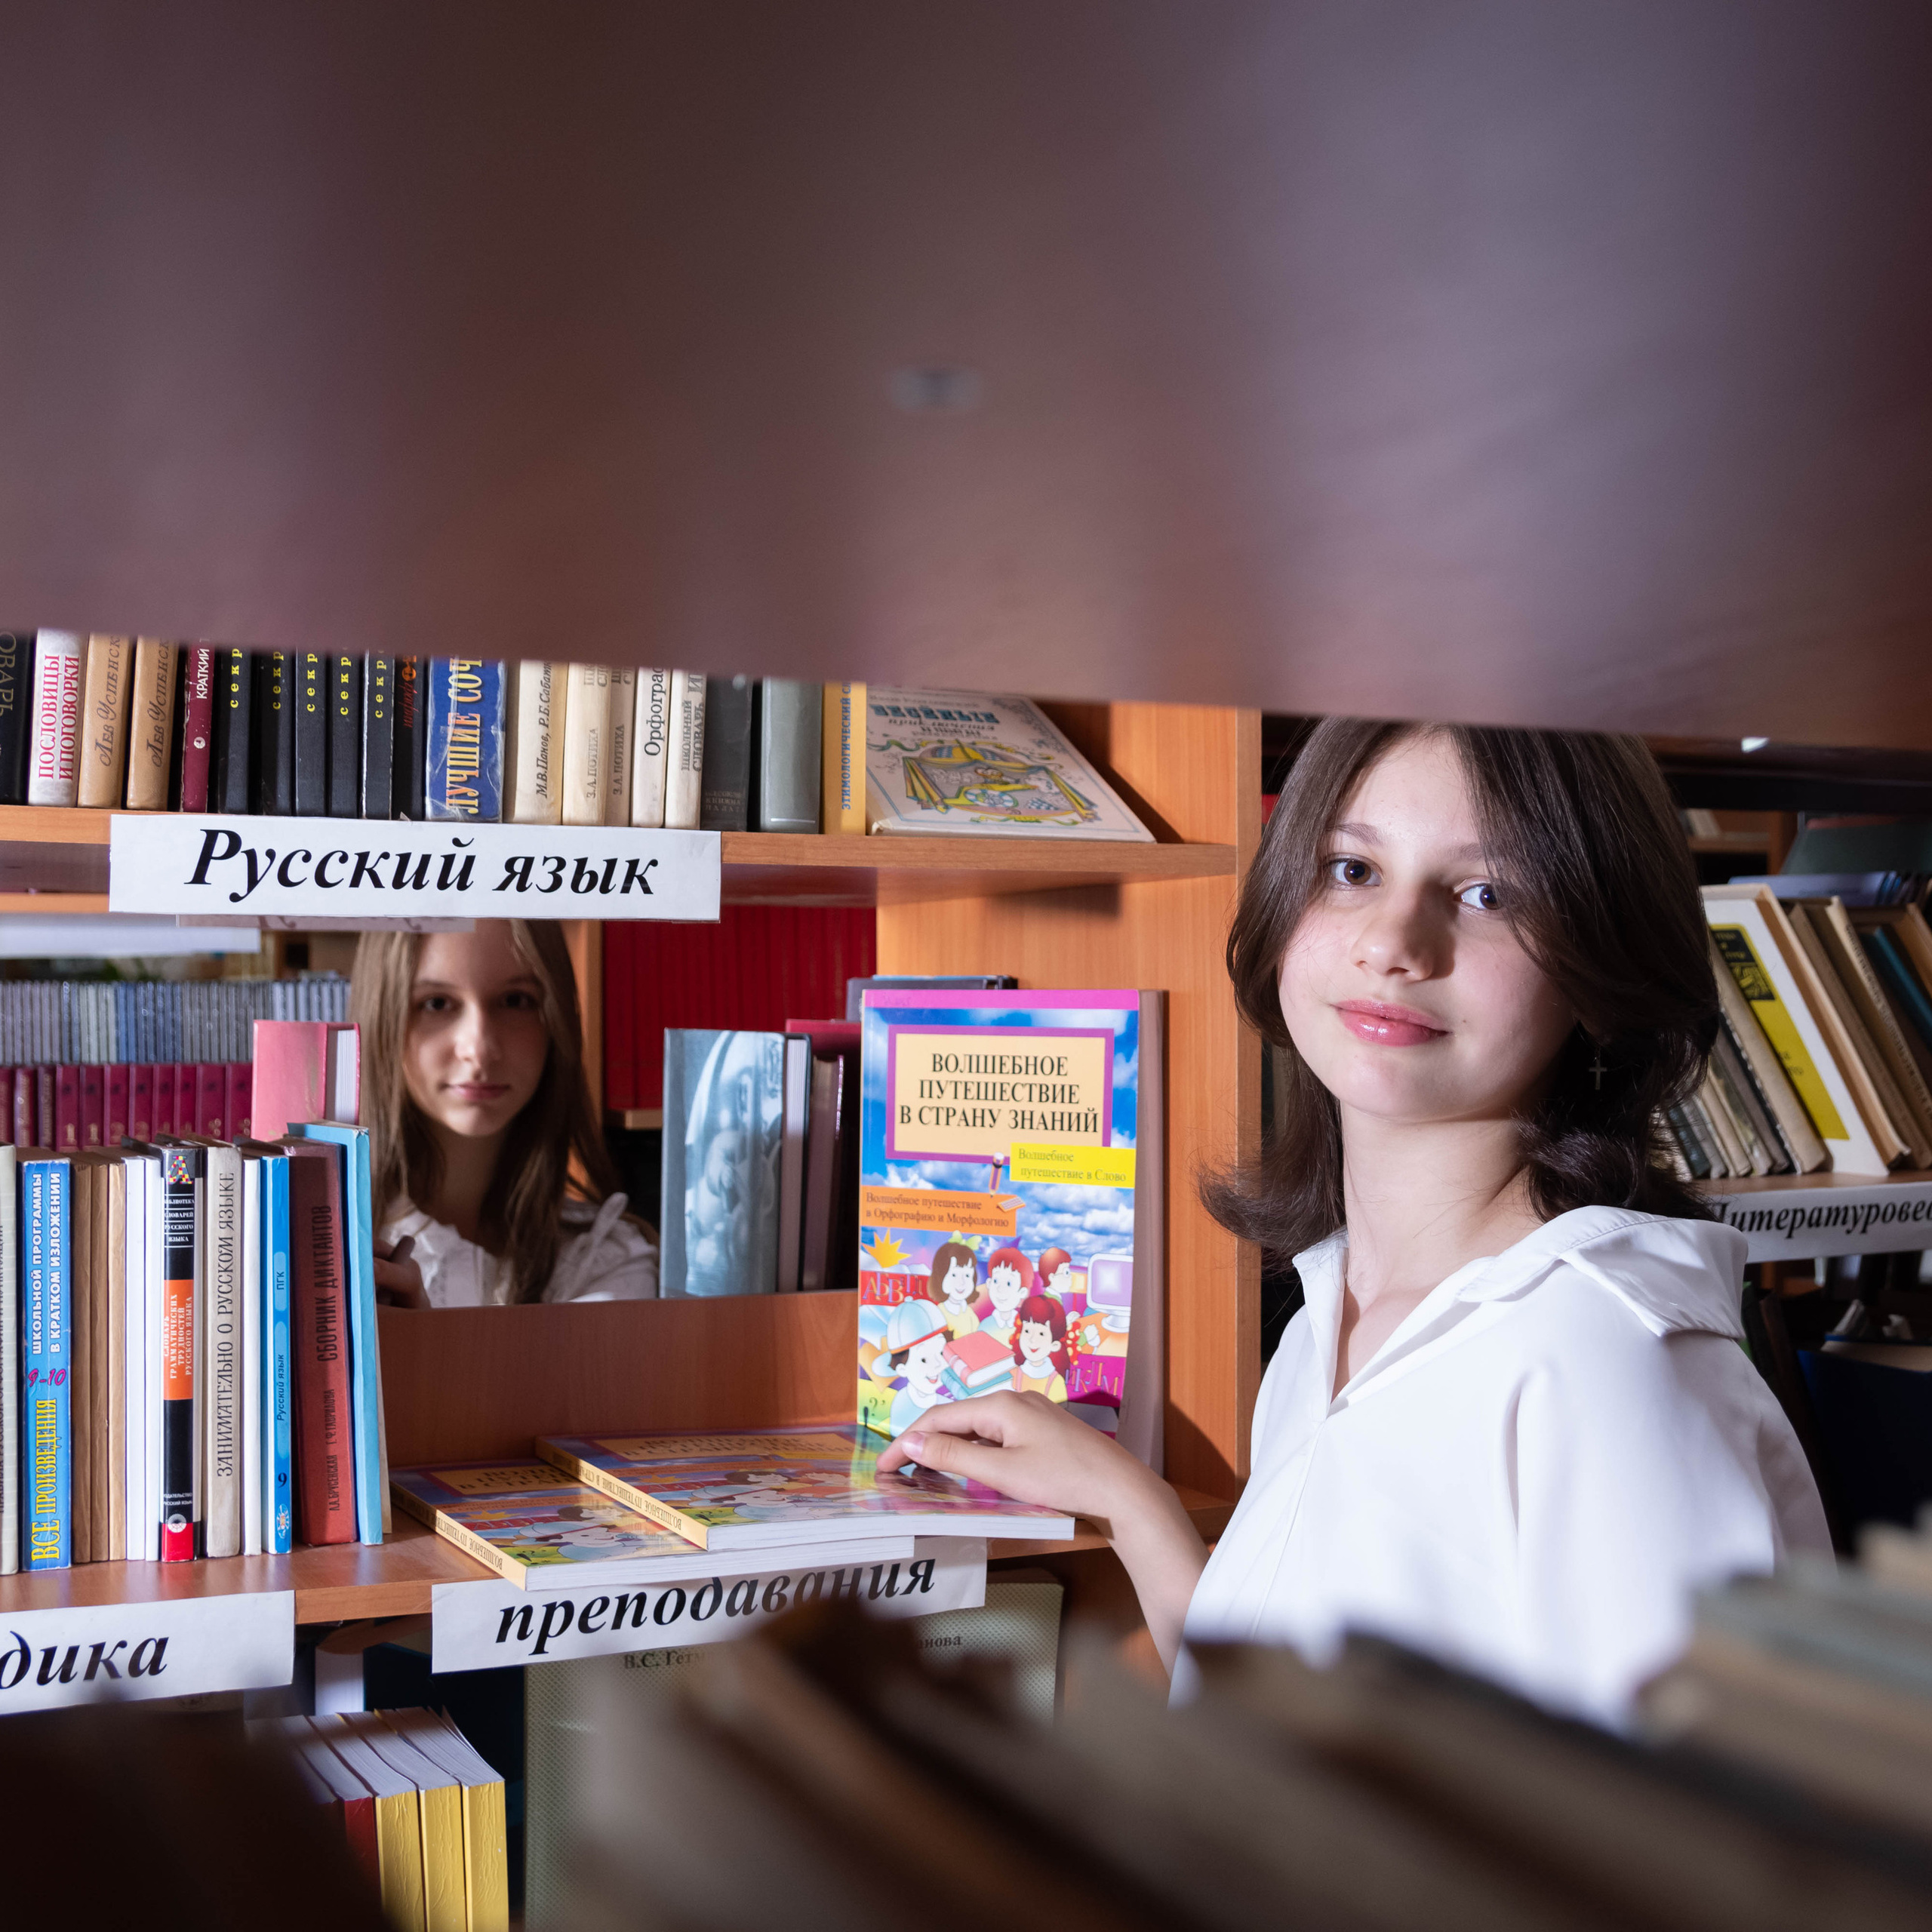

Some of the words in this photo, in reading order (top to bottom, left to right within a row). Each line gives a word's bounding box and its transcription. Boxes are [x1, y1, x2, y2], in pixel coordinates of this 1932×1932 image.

[195, 648, 210, 699] КРАТКИЙ
[448, 657, 482, 703] СОЧ
[38, 654, 62, 780] ПОСЛОВИЦЫ
[60, 655, 80, 764] ПОГОВОРКИ
[681, 700, 692, 771] ШКОЛЬНЫЙ
[692, 701, 704, 773] СЛОВАРЬ
[840, 697, 851, 811] ЭТИМОЛОГИЧЕСКИЙ
[59, 769, 73, 780] И
[445, 712, 481, 815] ЛУЧШИЕ
[183, 828, 475, 903] Русский
[491, 854, 660, 895] язык
[931, 1053, 1069, 1076] ВОЛШЕБНОЕ
[918, 1078, 1080, 1104] ПУТЕШЕСТВИЕ
[899, 1104, 912, 1124] В
[918, 1105, 1001, 1128] СТРАНУ
[1008, 1106, 1099, 1133] ЗНАНИЙ
[1018, 1148, 1074, 1162] Волшебное
[1020, 1167, 1084, 1180] путешествие
[1086, 1171, 1092, 1180] в
[1094, 1168, 1127, 1182] Слово
[32, 1173, 42, 1265] ПРОГРАММЫ
[50, 1172, 61, 1267] ИЗЛОЖЕНИИ
[219, 1172, 235, 1232] ЯЗЫКЕ
[866, 1192, 919, 1206] Волшебное
[921, 1198, 983, 1211] путешествие
[873, 1207, 936, 1223] Орфографию
[946, 1212, 1010, 1228] Морфологию
[1712, 1198, 1932, 1240] Литературове
[312, 1204, 338, 1289] ДИКТАНТОВ
[217, 1236, 233, 1315] РУССКОМ
[276, 1271, 285, 1291] ПГК
[30, 1269, 42, 1355] ШКОЛЬНОЙ
[50, 1271, 61, 1340] КРАТКОМ
[217, 1323, 233, 1334] О
[315, 1295, 338, 1362] СБОРНИК
[50, 1342, 61, 1354] В
[177, 1306, 186, 1366] ТРУДНОСТЕЙ
[27, 1368, 66, 1388] 9-10
[276, 1381, 285, 1421] Русский
[217, 1341, 233, 1477] ЗАНИМАТЕЛЬНО
[35, 1398, 62, 1515] ПРОИЗВЕДЕНИЯ
[278, 1472, 287, 1488] 9
[602, 1477, 642, 1509] ПУТЕШЕСТВИЕ
[644, 1500, 682, 1531] ВОЛШЕБНОЕ
[30, 1518, 60, 1561] ВСЕ
[469, 1537, 503, 1571] ВОЛШЕБНОЕ
[495, 1558, 936, 1655] преподавания
